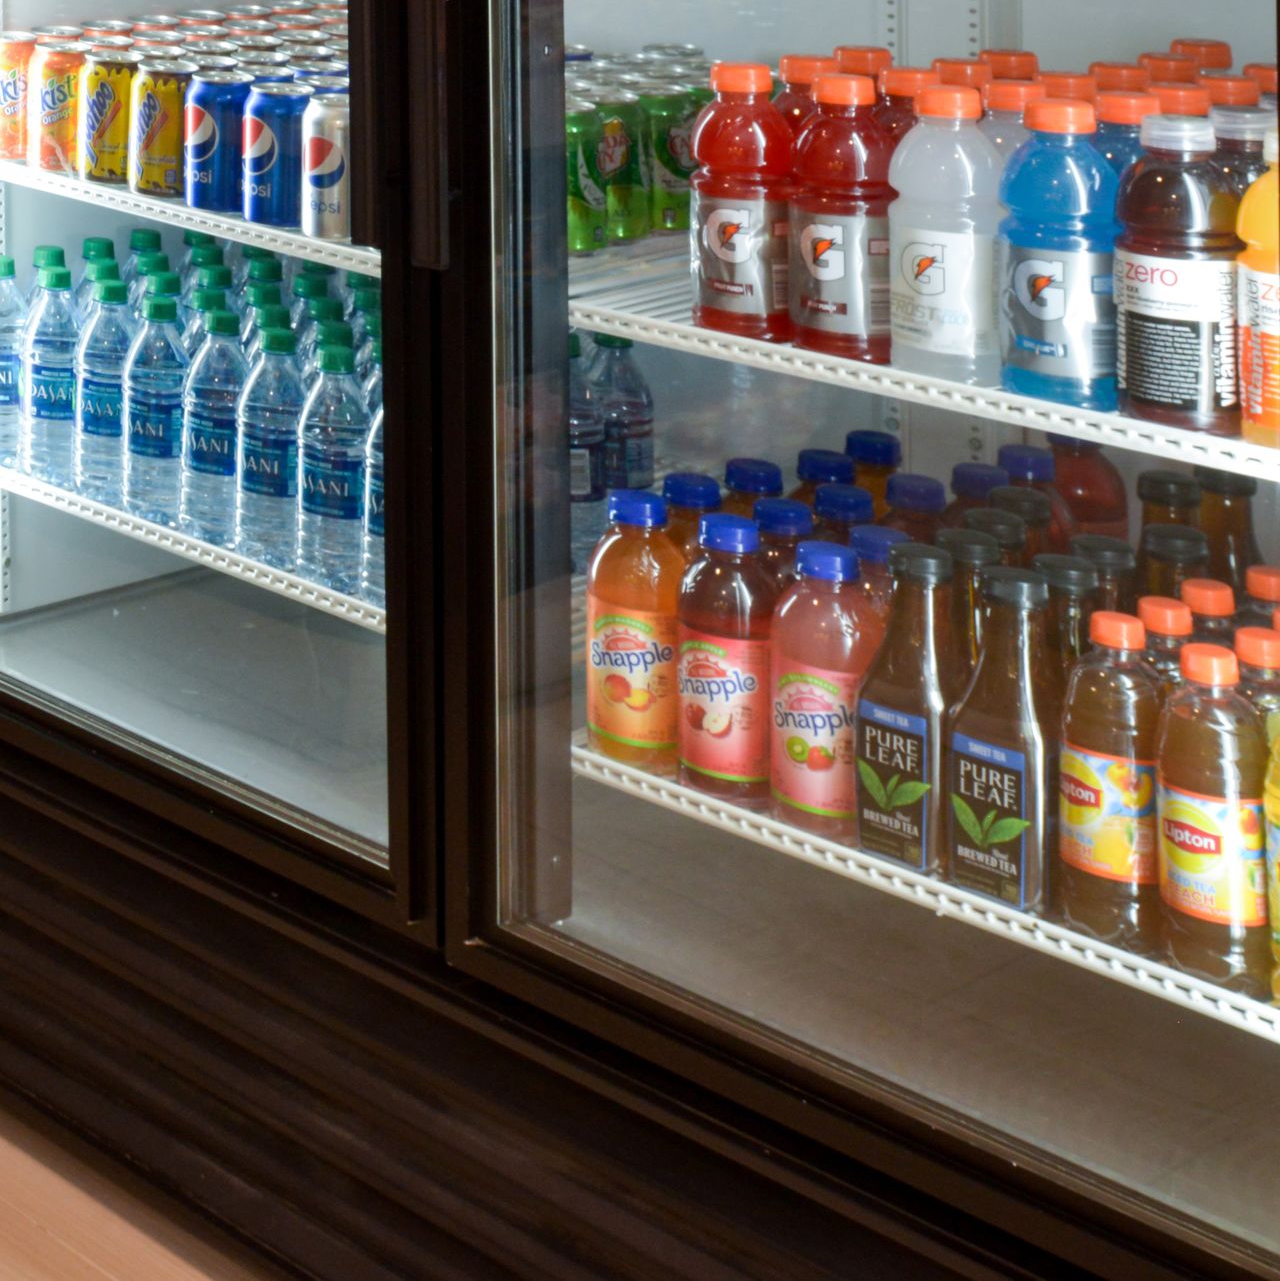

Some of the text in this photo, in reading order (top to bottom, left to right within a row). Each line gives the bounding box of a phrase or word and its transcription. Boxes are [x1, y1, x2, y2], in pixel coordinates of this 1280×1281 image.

[706, 208, 752, 263] G
[800, 223, 845, 281] G
[1013, 258, 1067, 321] G
[1125, 261, 1178, 287] zero
[591, 643, 673, 673] Snapple
[865, 726, 919, 758] PURE
[959, 760, 1017, 794] PURE
[863, 809, 919, 838] BREWED TEA
[1163, 821, 1217, 852] Lipton
[957, 844, 1017, 876] BREWED TEA
